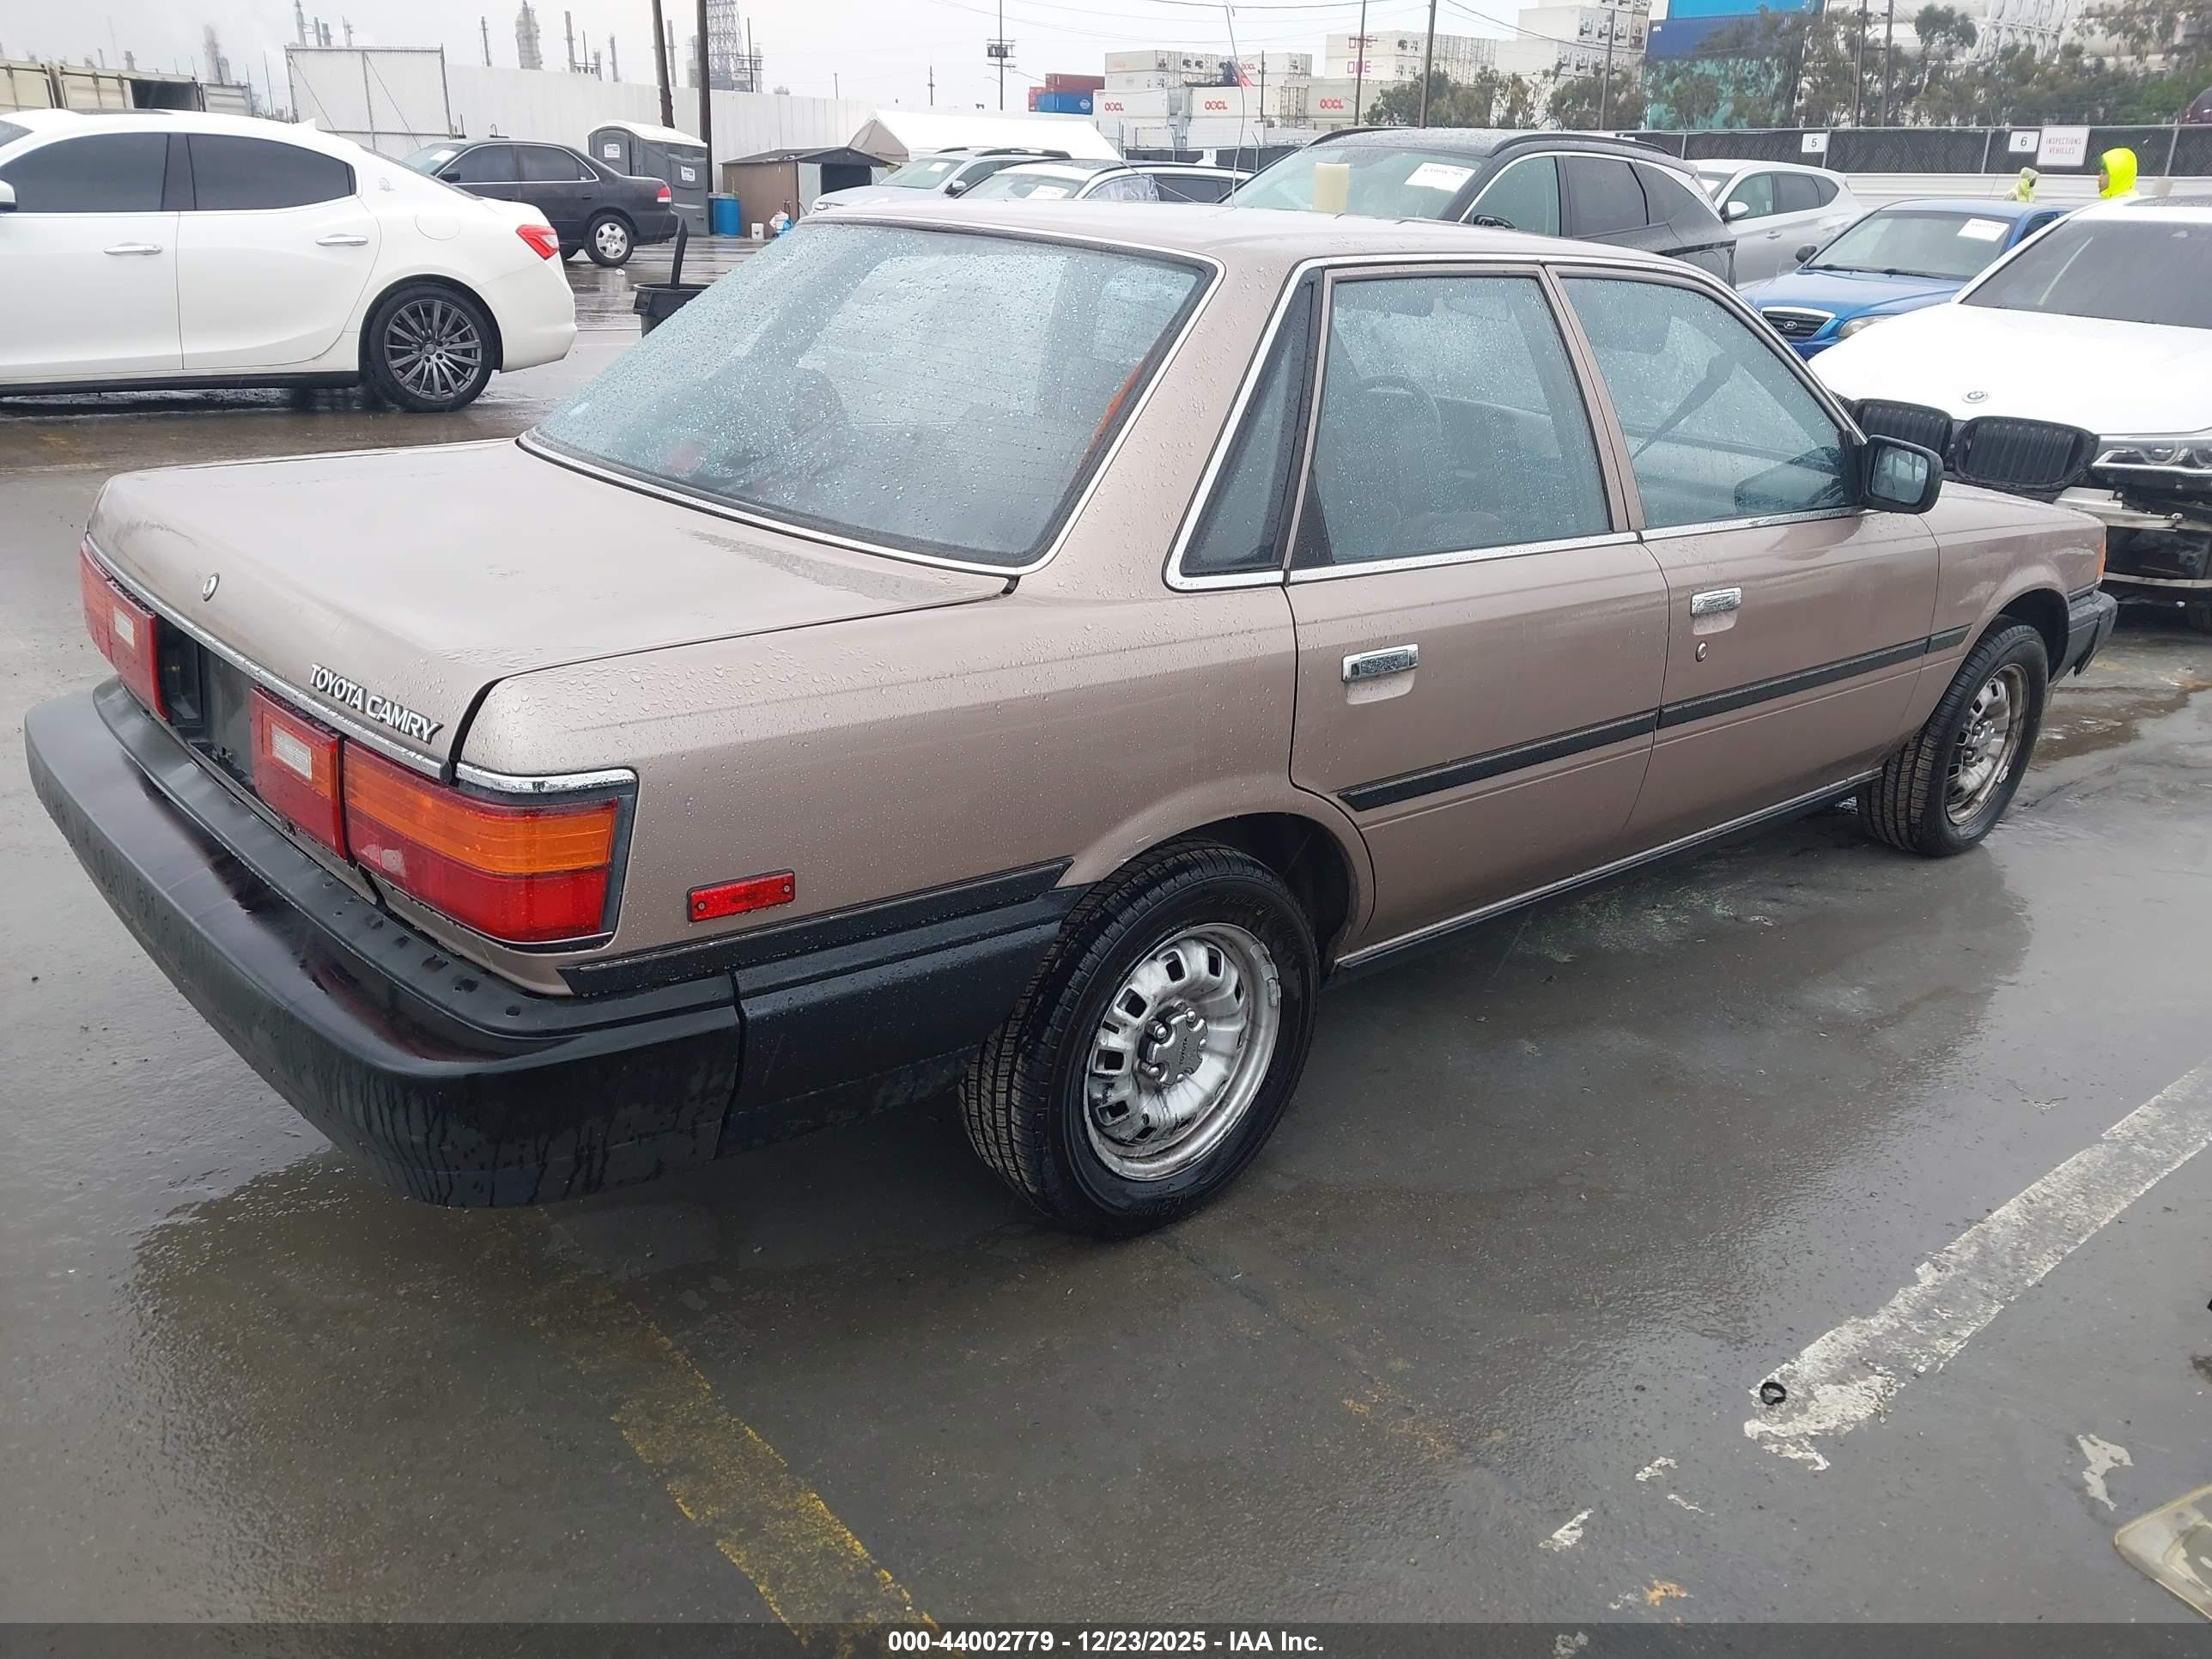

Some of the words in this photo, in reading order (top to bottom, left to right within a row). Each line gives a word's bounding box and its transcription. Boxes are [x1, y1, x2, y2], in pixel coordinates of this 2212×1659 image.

[1104, 102, 1125, 112] OOCL
[1204, 100, 1228, 110] OOCL
[1320, 99, 1344, 109] OOCL
[1811, 137, 1818, 148] 5
[2021, 137, 2028, 147] 6
[2045, 137, 2081, 145] INSPECTIONS
[2048, 146, 2075, 155] VEHICLES
[310, 662, 367, 714] TOYOTA
[366, 695, 443, 745] CAMRY
